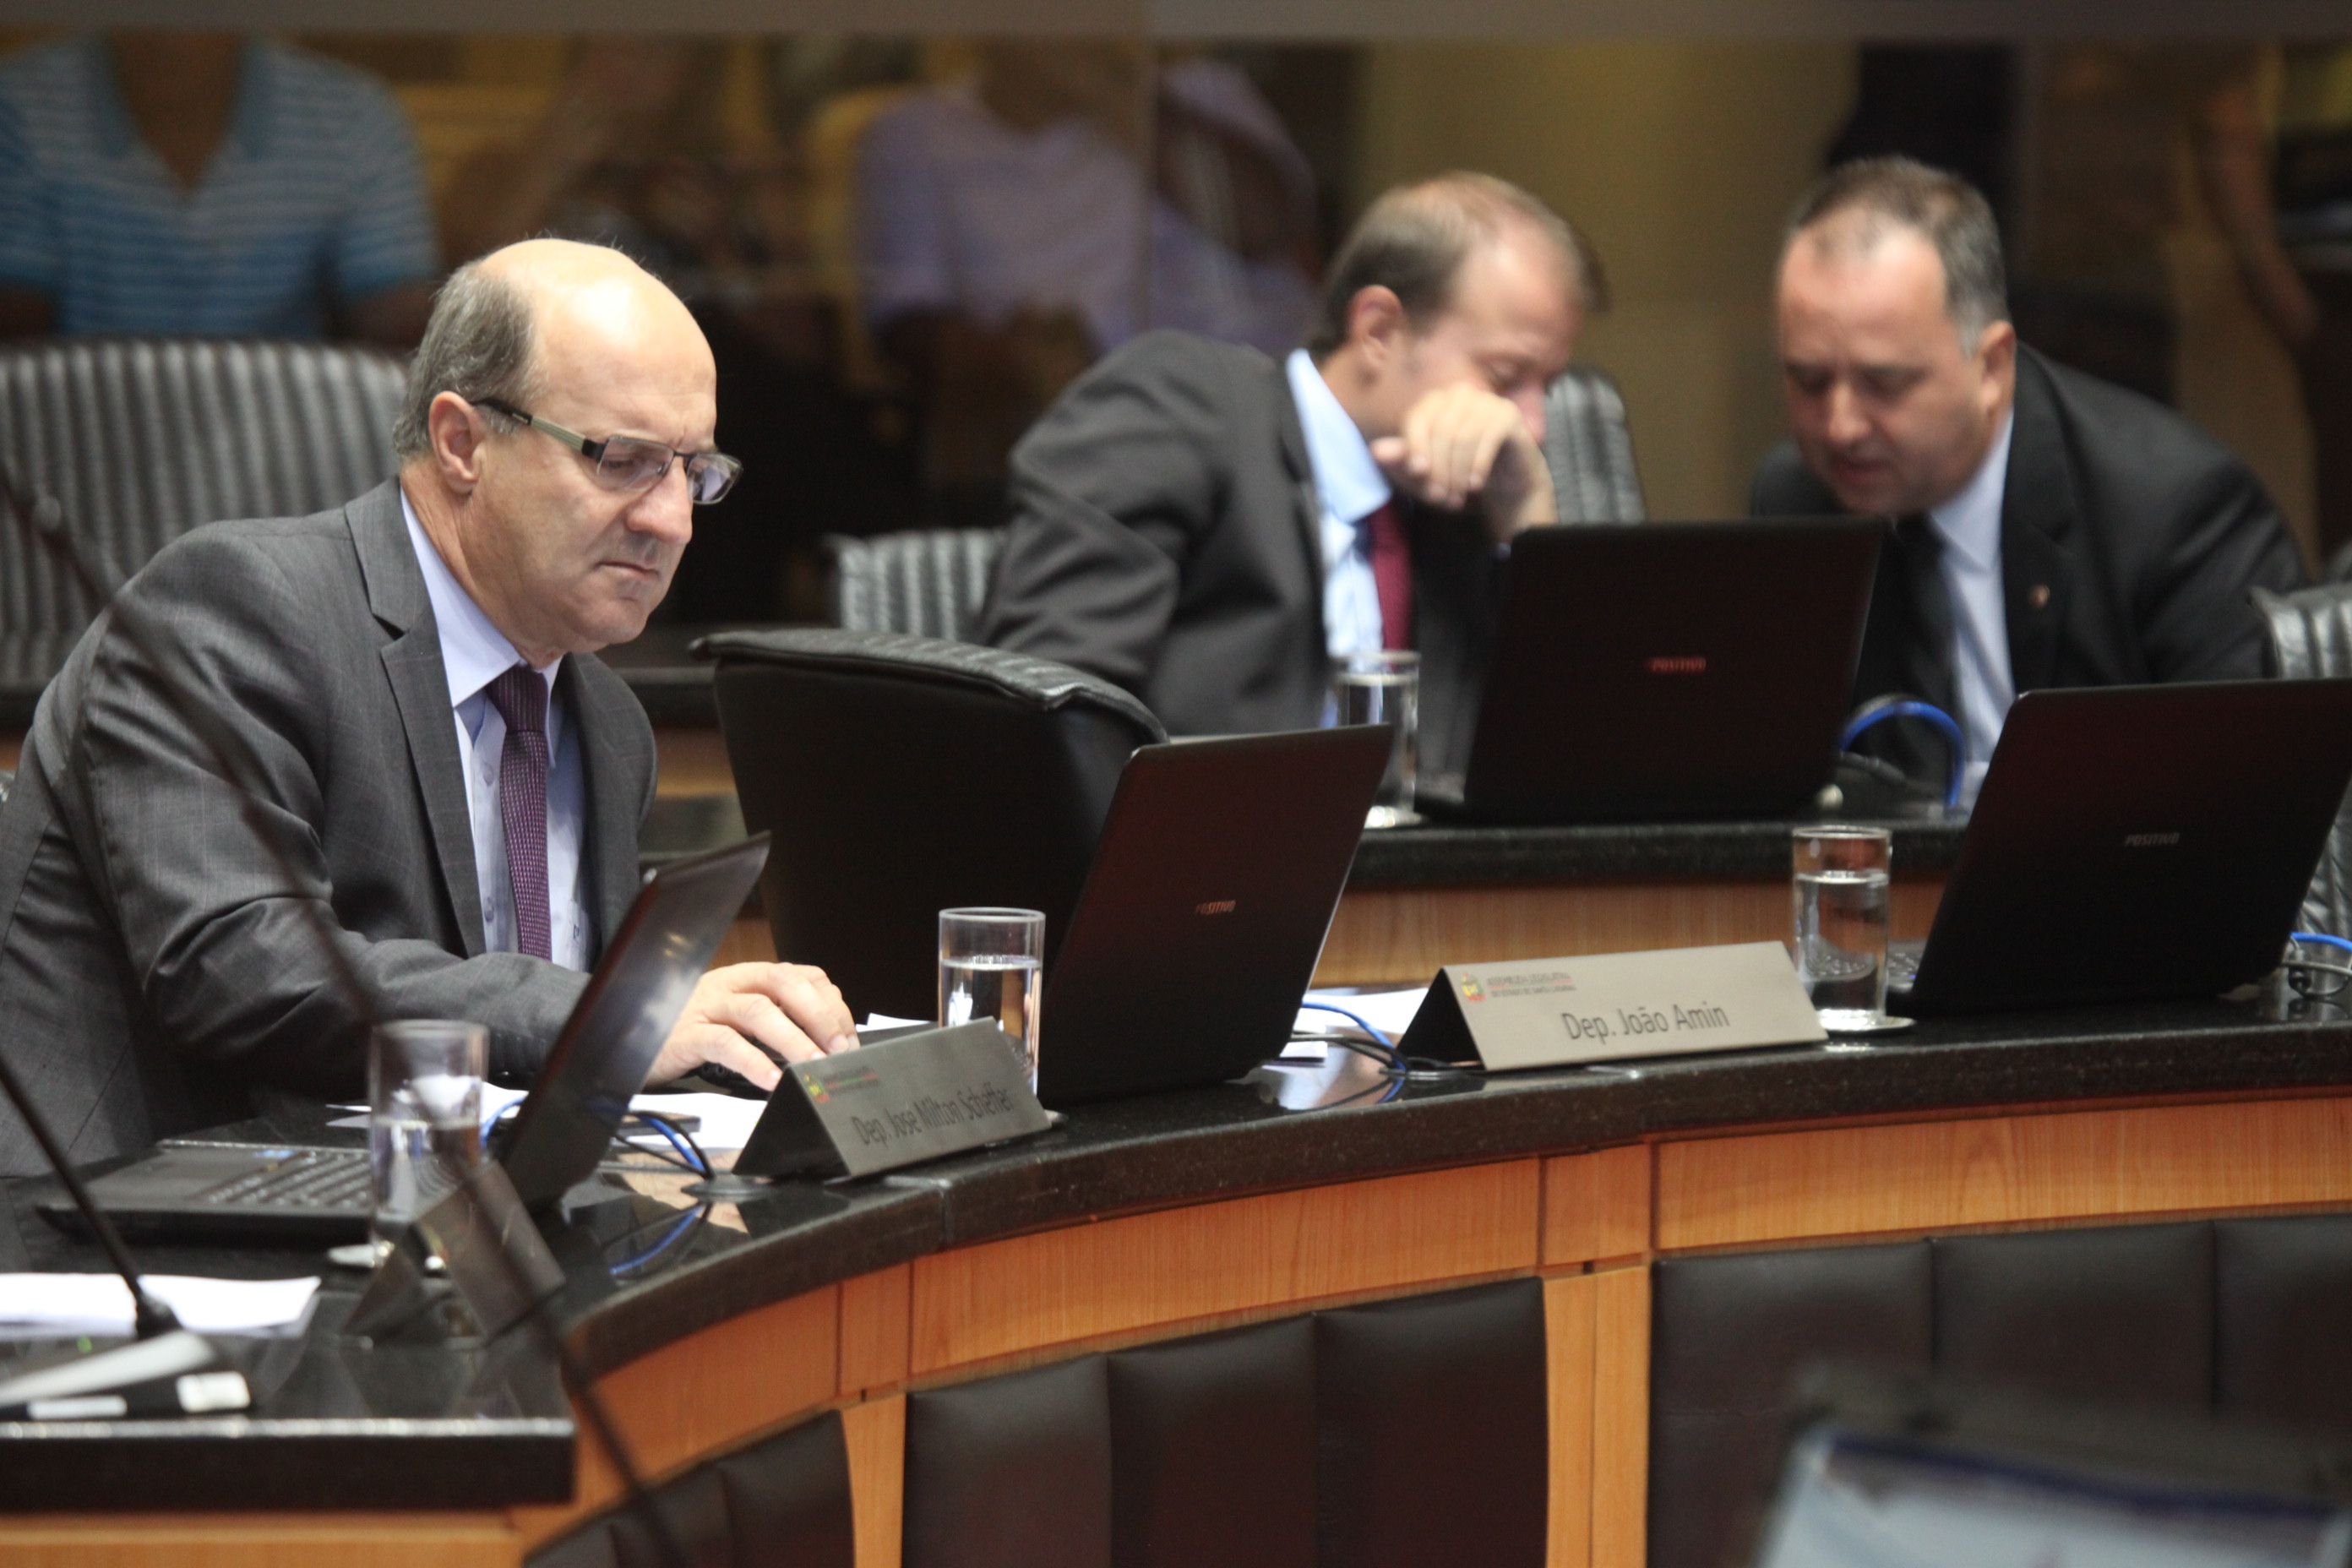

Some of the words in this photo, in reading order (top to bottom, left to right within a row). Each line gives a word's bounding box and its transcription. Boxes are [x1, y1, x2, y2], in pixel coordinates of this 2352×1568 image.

[1561, 1012, 1617, 1045] Dep.
[1617, 1007, 1669, 1036] João
[1672, 1001, 1731, 1031] Amin
[851, 1115, 892, 1150] Dep.
[956, 1081, 1015, 1121] Scheffer
